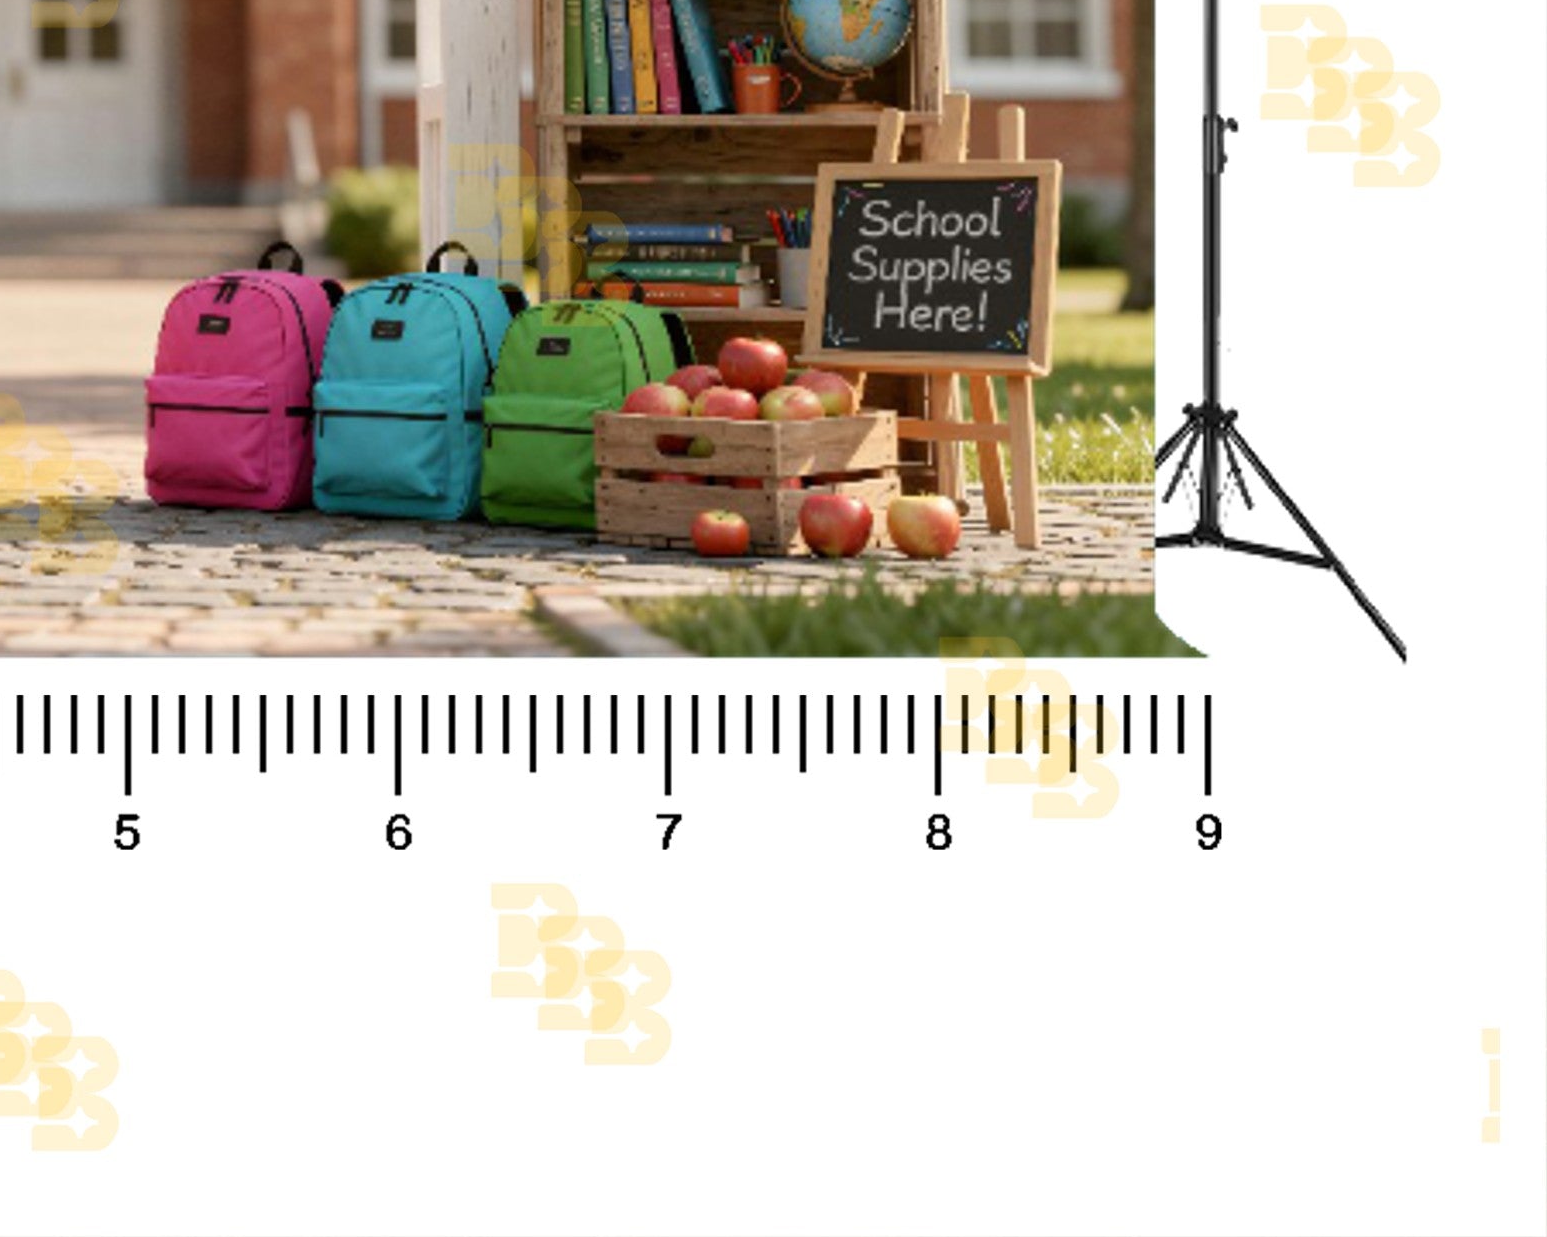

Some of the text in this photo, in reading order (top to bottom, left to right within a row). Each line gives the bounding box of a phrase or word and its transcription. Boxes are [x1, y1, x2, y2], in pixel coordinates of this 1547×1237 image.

[858, 195, 1002, 238] School
[847, 244, 1013, 295] Supplies
[873, 290, 989, 333] Here!
